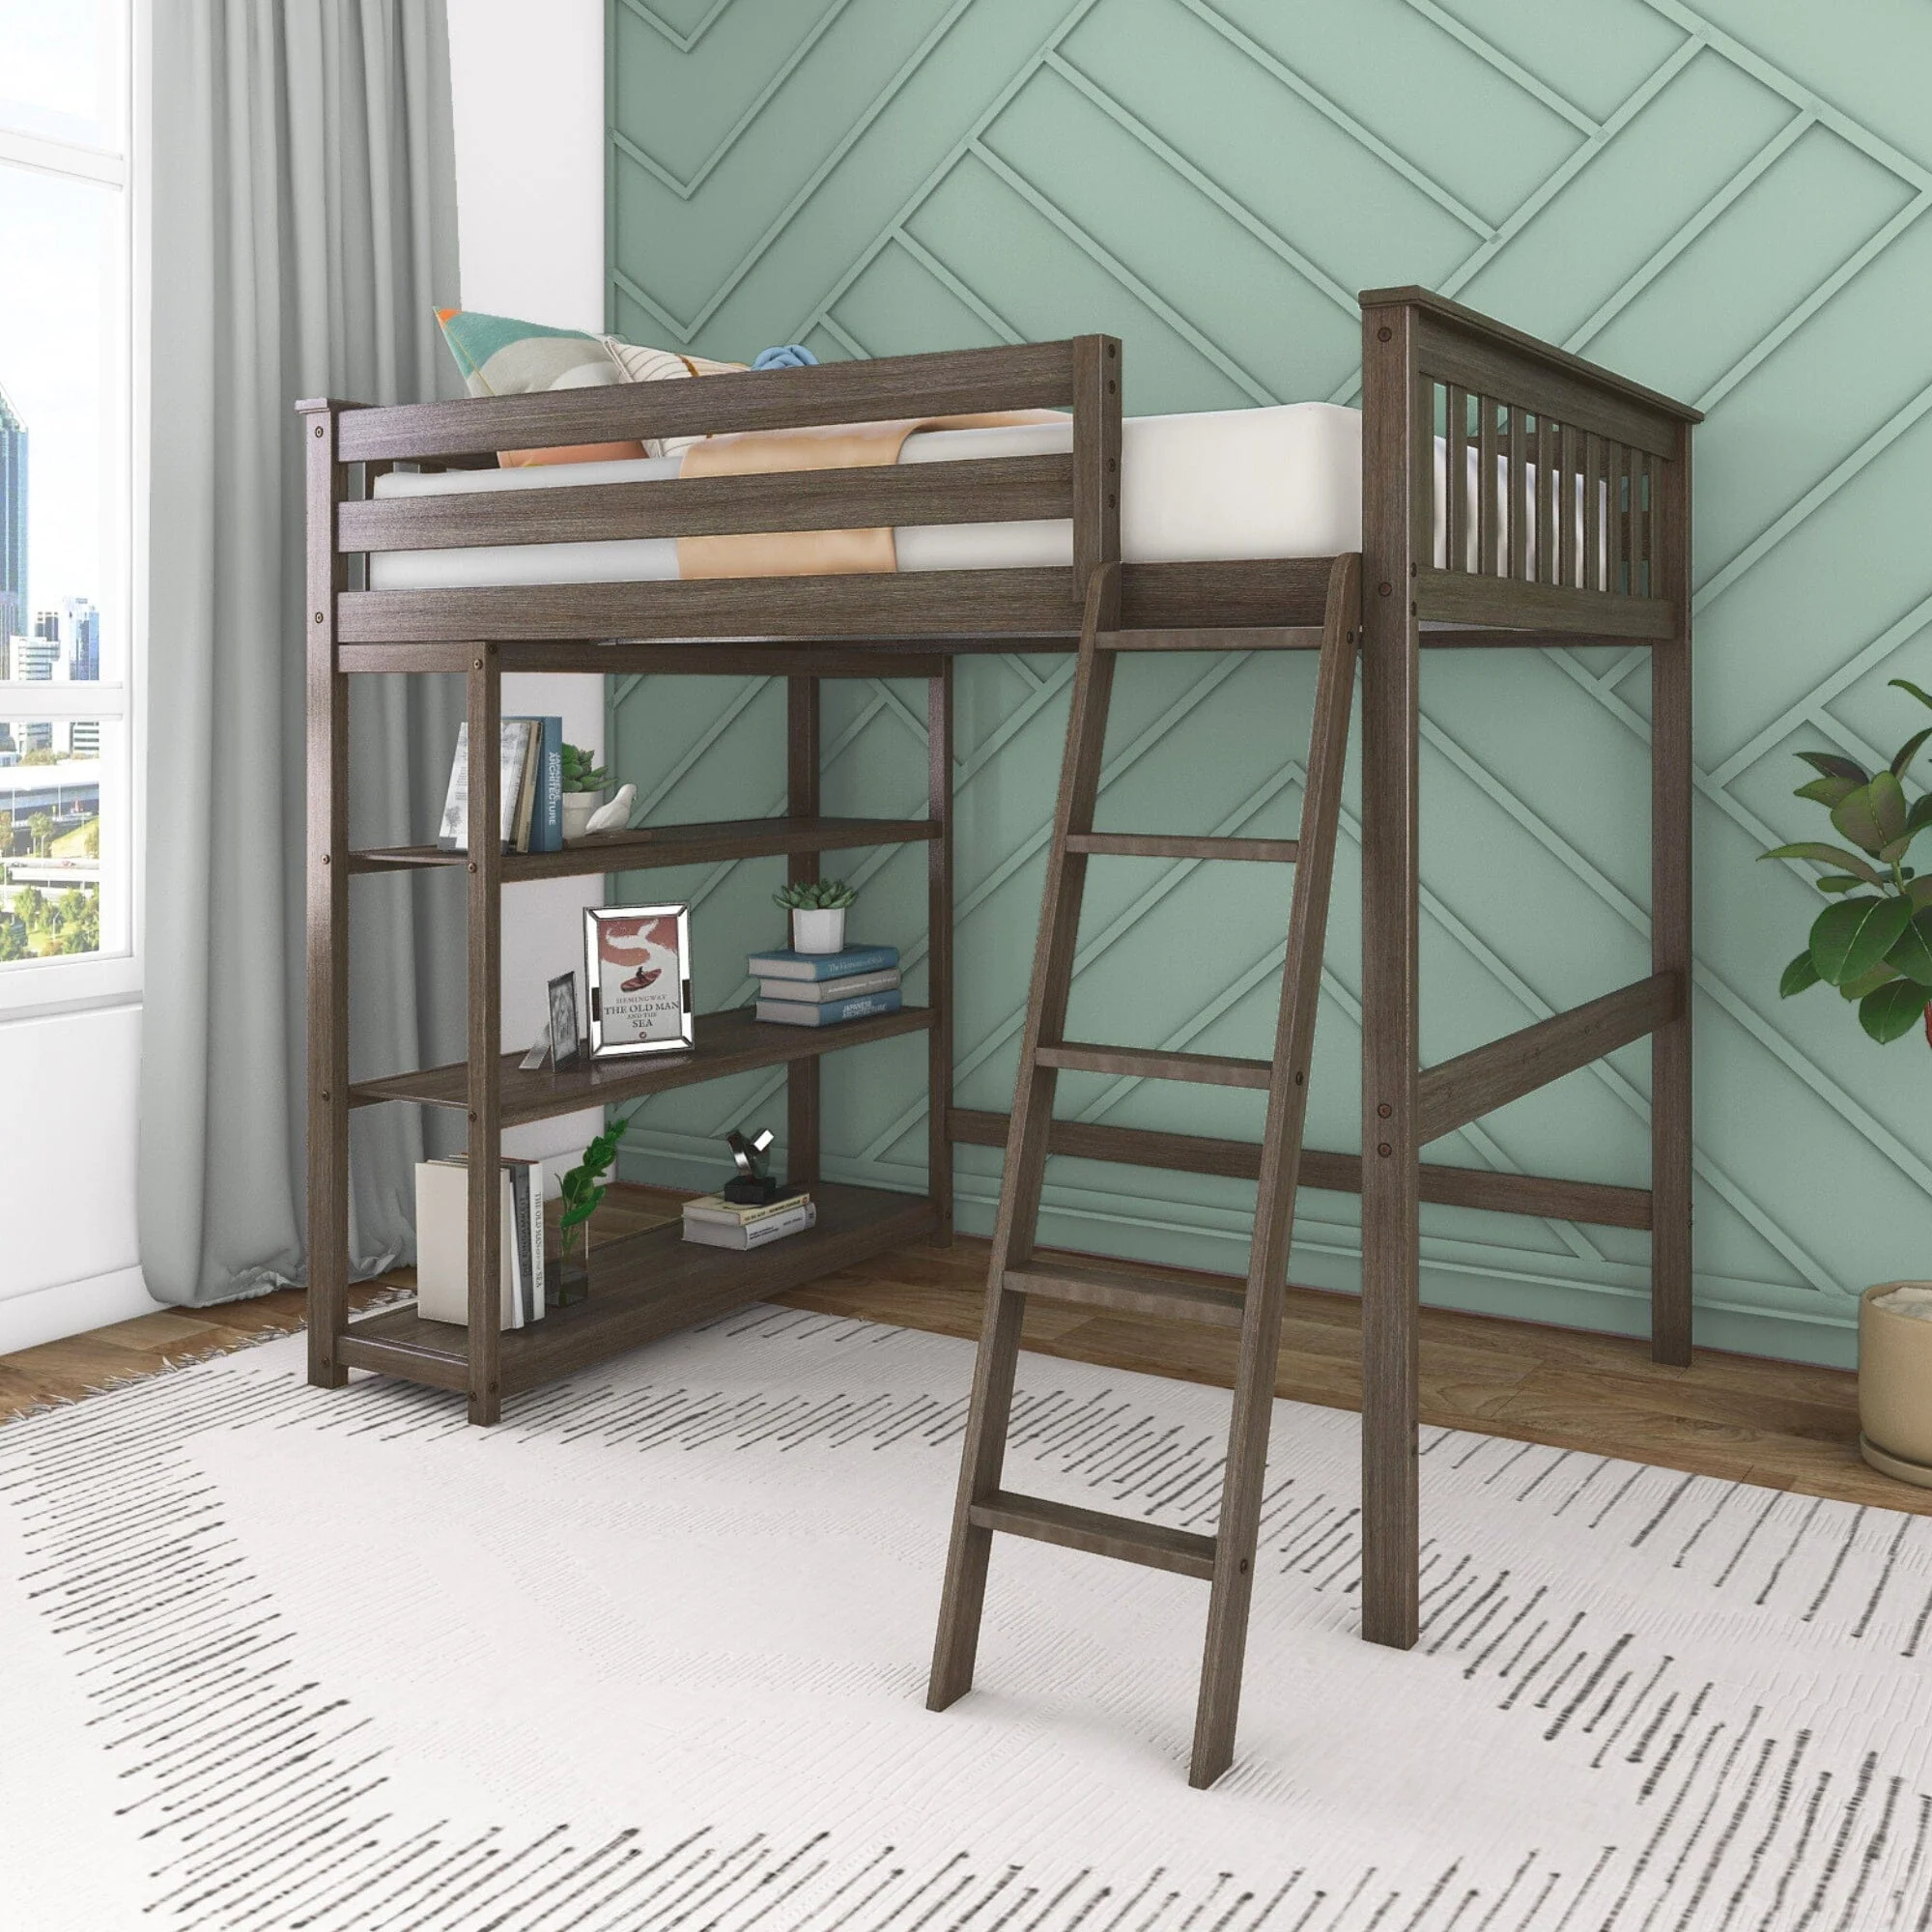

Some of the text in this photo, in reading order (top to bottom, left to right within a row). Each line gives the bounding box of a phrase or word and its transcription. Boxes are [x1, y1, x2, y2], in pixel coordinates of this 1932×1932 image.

[616, 994, 667, 1004] HEMINGWAY
[604, 1001, 679, 1015] THE OLD MAN
[632, 1019, 653, 1028] SEA
